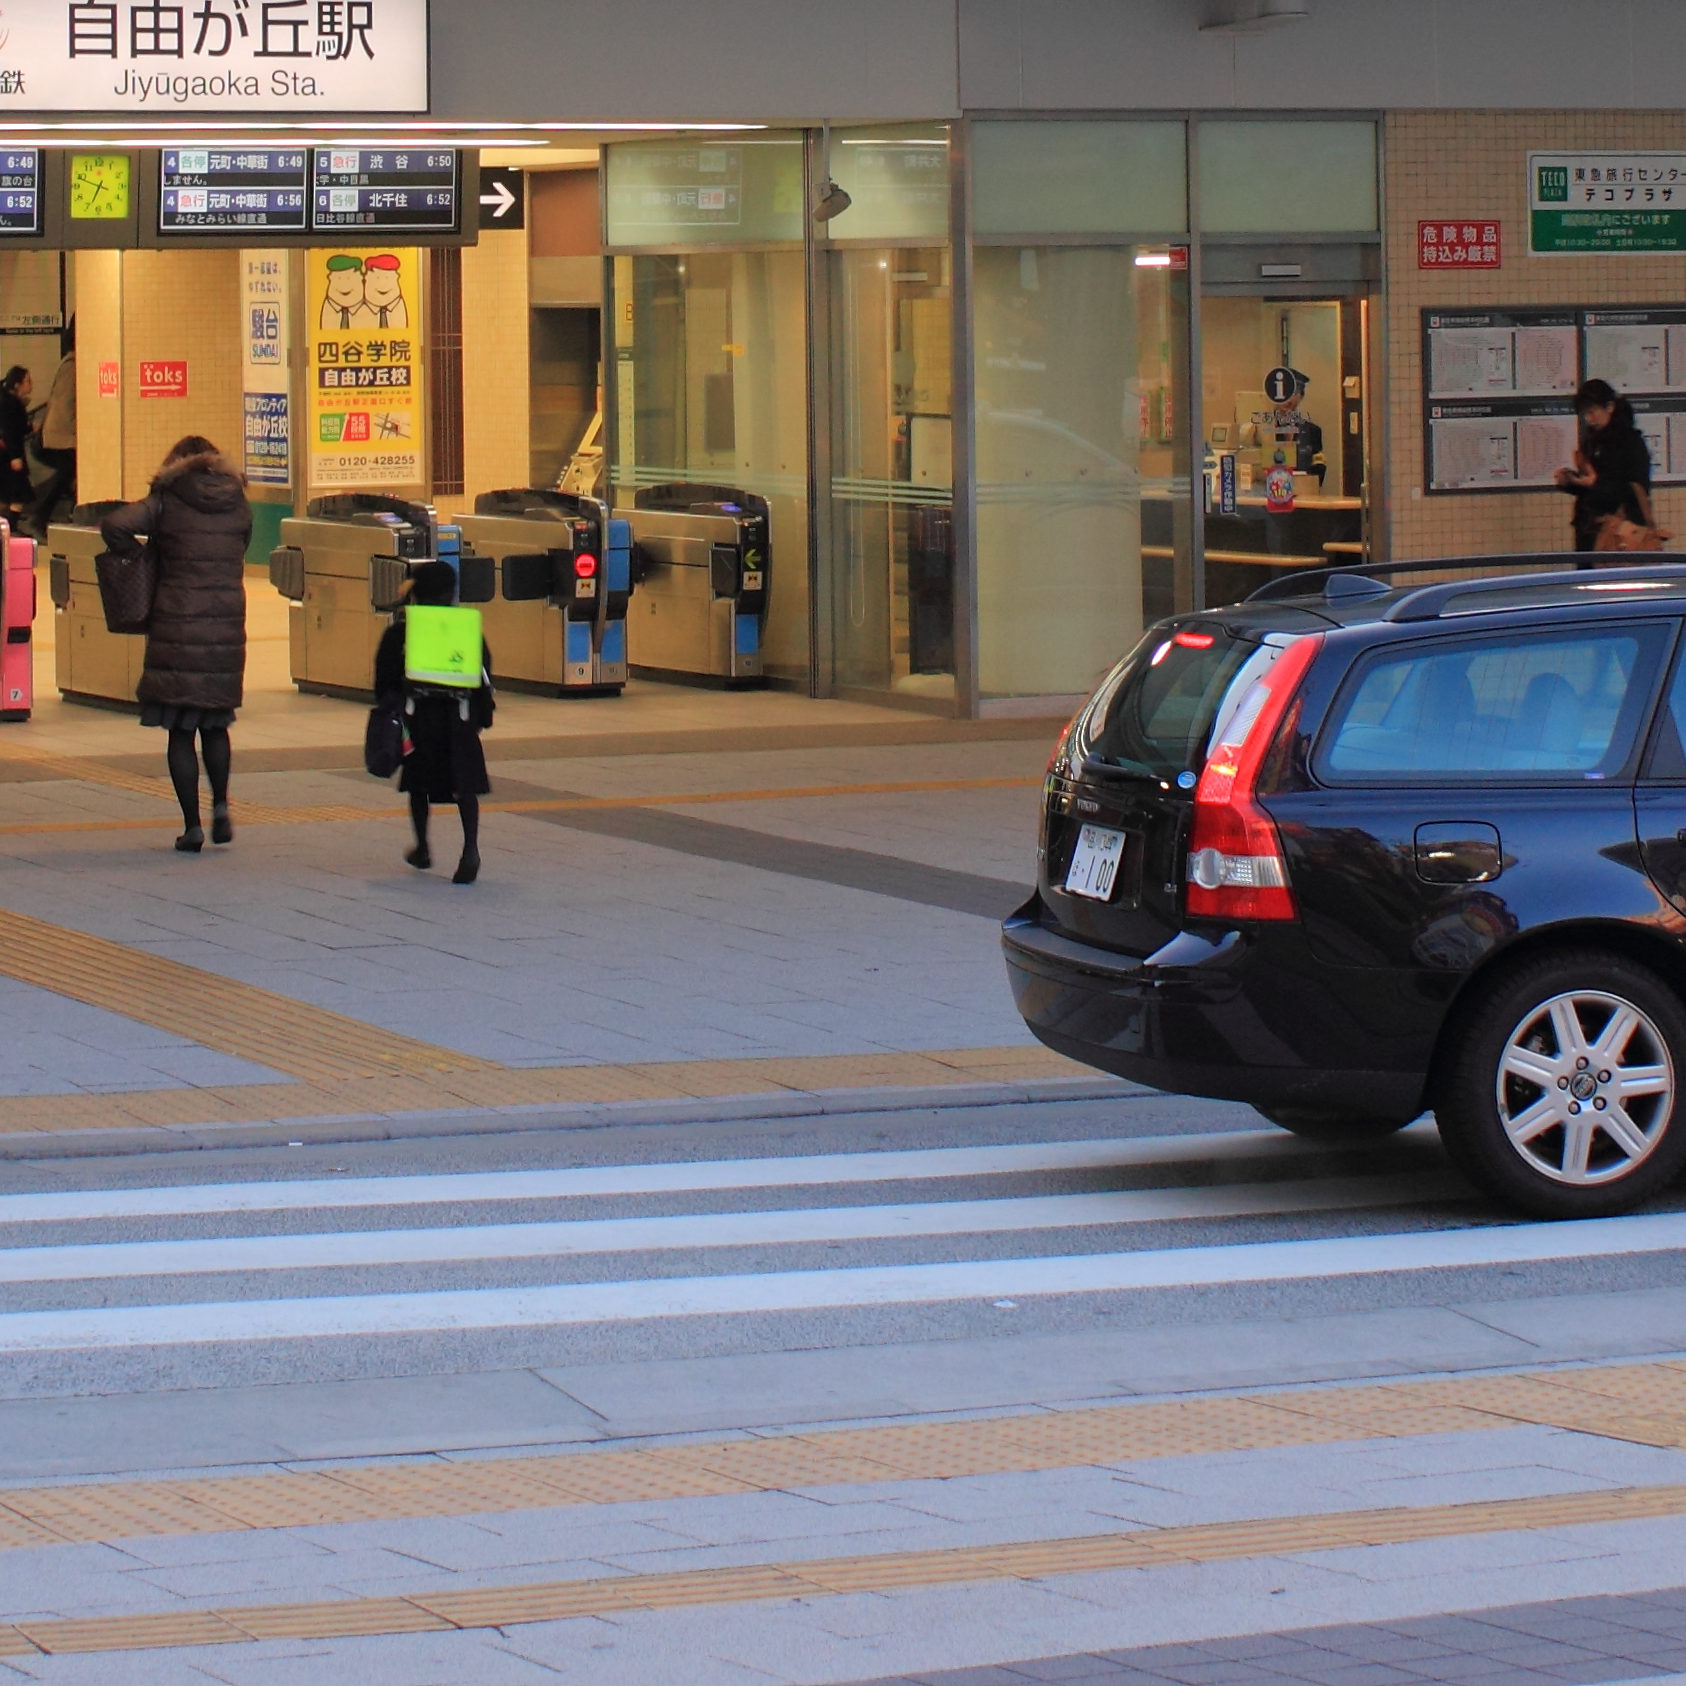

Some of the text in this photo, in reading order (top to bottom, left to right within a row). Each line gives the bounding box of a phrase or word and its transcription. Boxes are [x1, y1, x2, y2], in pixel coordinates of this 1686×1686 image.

[114, 69, 326, 102] Jiyūgaoka Sta.
[7, 156, 34, 168] 6:49
[167, 155, 303, 170] 4 各停 元町・中華街 6:49
[319, 155, 452, 169] 5 急行 渋谷 6:50
[1541, 171, 1566, 187] TECO
[7, 196, 33, 208] 6:52
[167, 194, 302, 208] 4 急行 元町・中華街 6:56
[319, 196, 327, 206] 6
[369, 193, 408, 207] 北千住
[426, 194, 451, 205] 6:52
[1585, 188, 1674, 202] テコプラザ
[175, 214, 268, 225] みなとみらい線直通
[1423, 226, 1497, 243] 危険物品
[1422, 245, 1497, 263] 持込み厳禁
[318, 340, 411, 363] 四谷学院
[100, 368, 118, 385] toks
[145, 366, 183, 383] toks
[324, 368, 407, 387] 自由が丘校
[245, 415, 288, 437] 自由が丘校
[339, 456, 415, 466] 0120-428255
